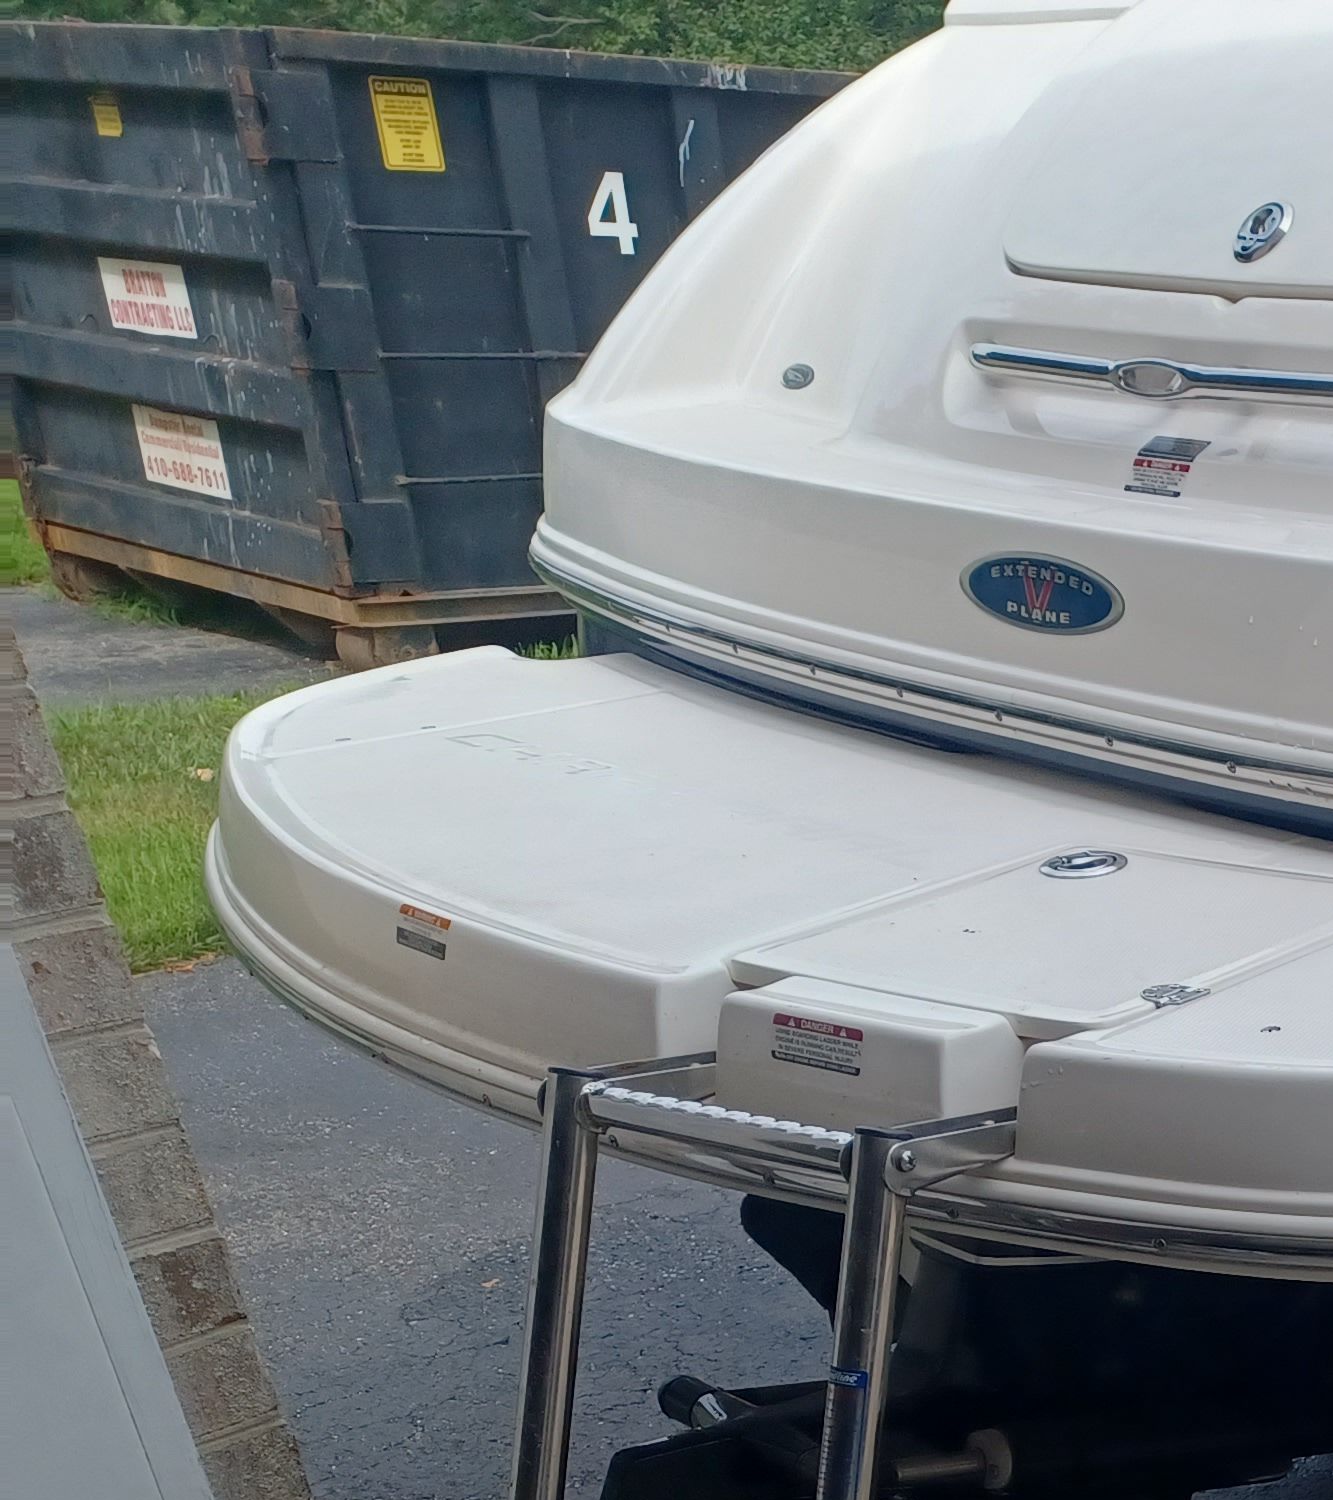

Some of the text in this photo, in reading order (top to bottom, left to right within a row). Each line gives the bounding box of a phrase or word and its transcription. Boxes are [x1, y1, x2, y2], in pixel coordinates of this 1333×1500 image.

[374, 82, 426, 94] CAUTION
[588, 171, 638, 255] 4
[111, 299, 193, 332] CONTRACTING LLC
[147, 455, 227, 491] 410-688-7611
[991, 565, 1094, 596] EXTENDED
[1006, 601, 1071, 624] PLANE
[800, 1019, 834, 1034] DANGER
